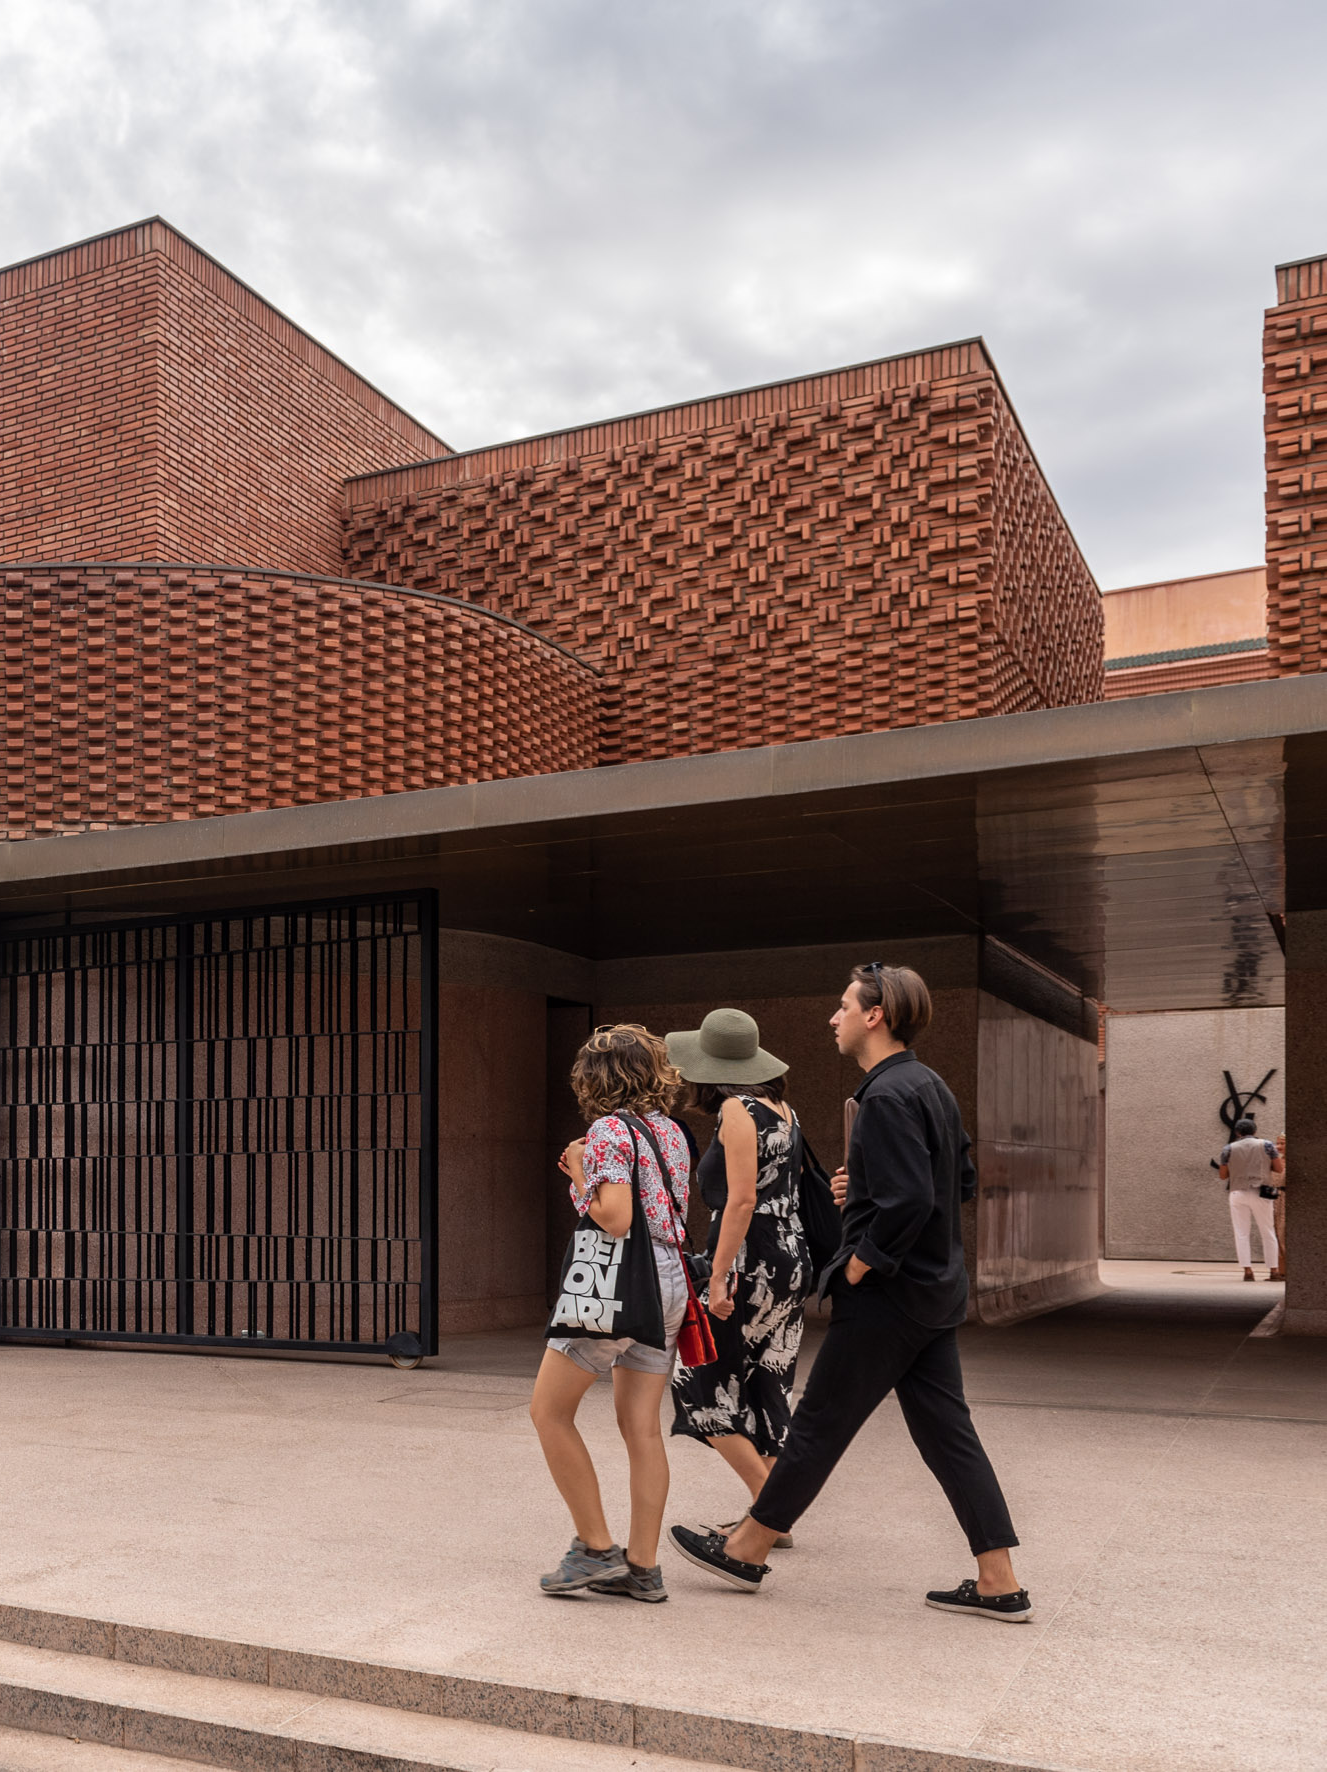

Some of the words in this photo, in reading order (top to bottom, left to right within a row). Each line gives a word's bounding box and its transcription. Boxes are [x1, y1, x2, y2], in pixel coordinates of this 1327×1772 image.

[573, 1229, 630, 1266] BET
[563, 1261, 618, 1299] ON
[550, 1293, 623, 1333] ART
